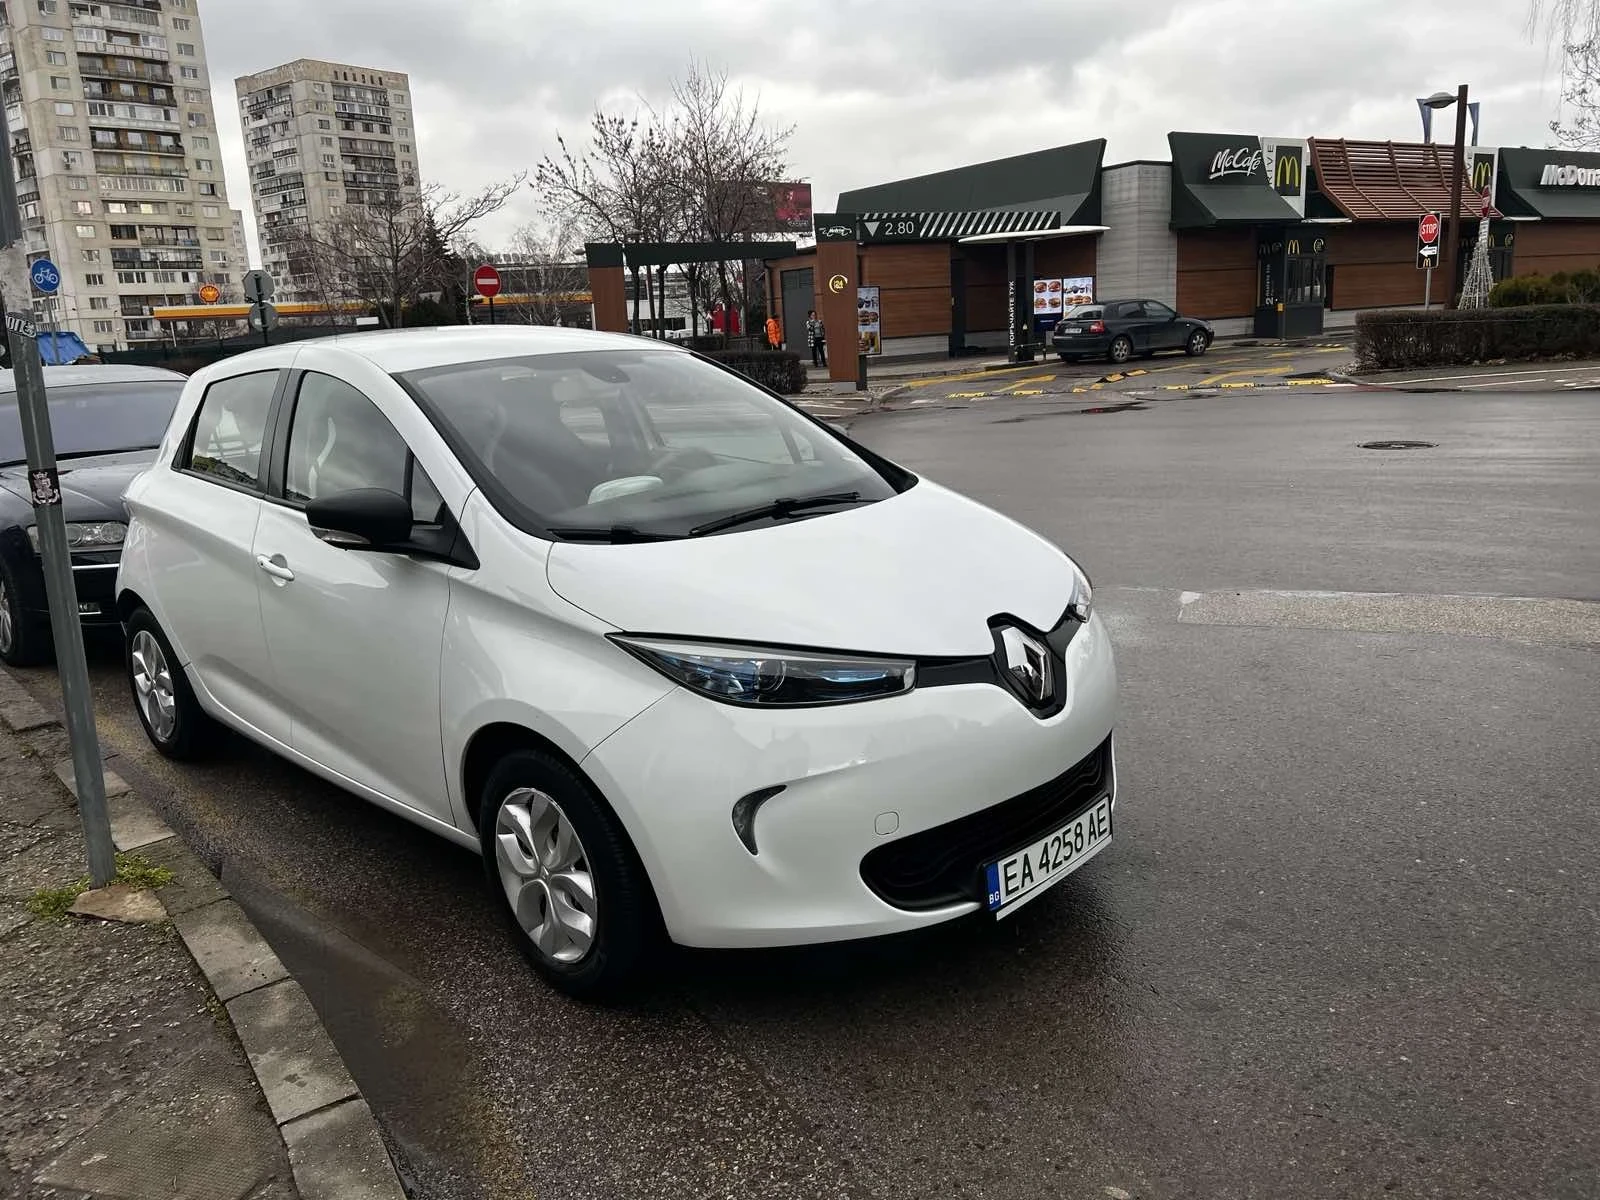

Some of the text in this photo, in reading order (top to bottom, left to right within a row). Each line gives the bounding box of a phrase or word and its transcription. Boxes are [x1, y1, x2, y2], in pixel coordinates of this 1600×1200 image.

[1209, 147, 1262, 179] McCafé
[884, 221, 914, 235] 2.80
[1421, 223, 1437, 235] STOP
[1003, 803, 1108, 896] EA 4258 AE
[989, 891, 1000, 904] BG
